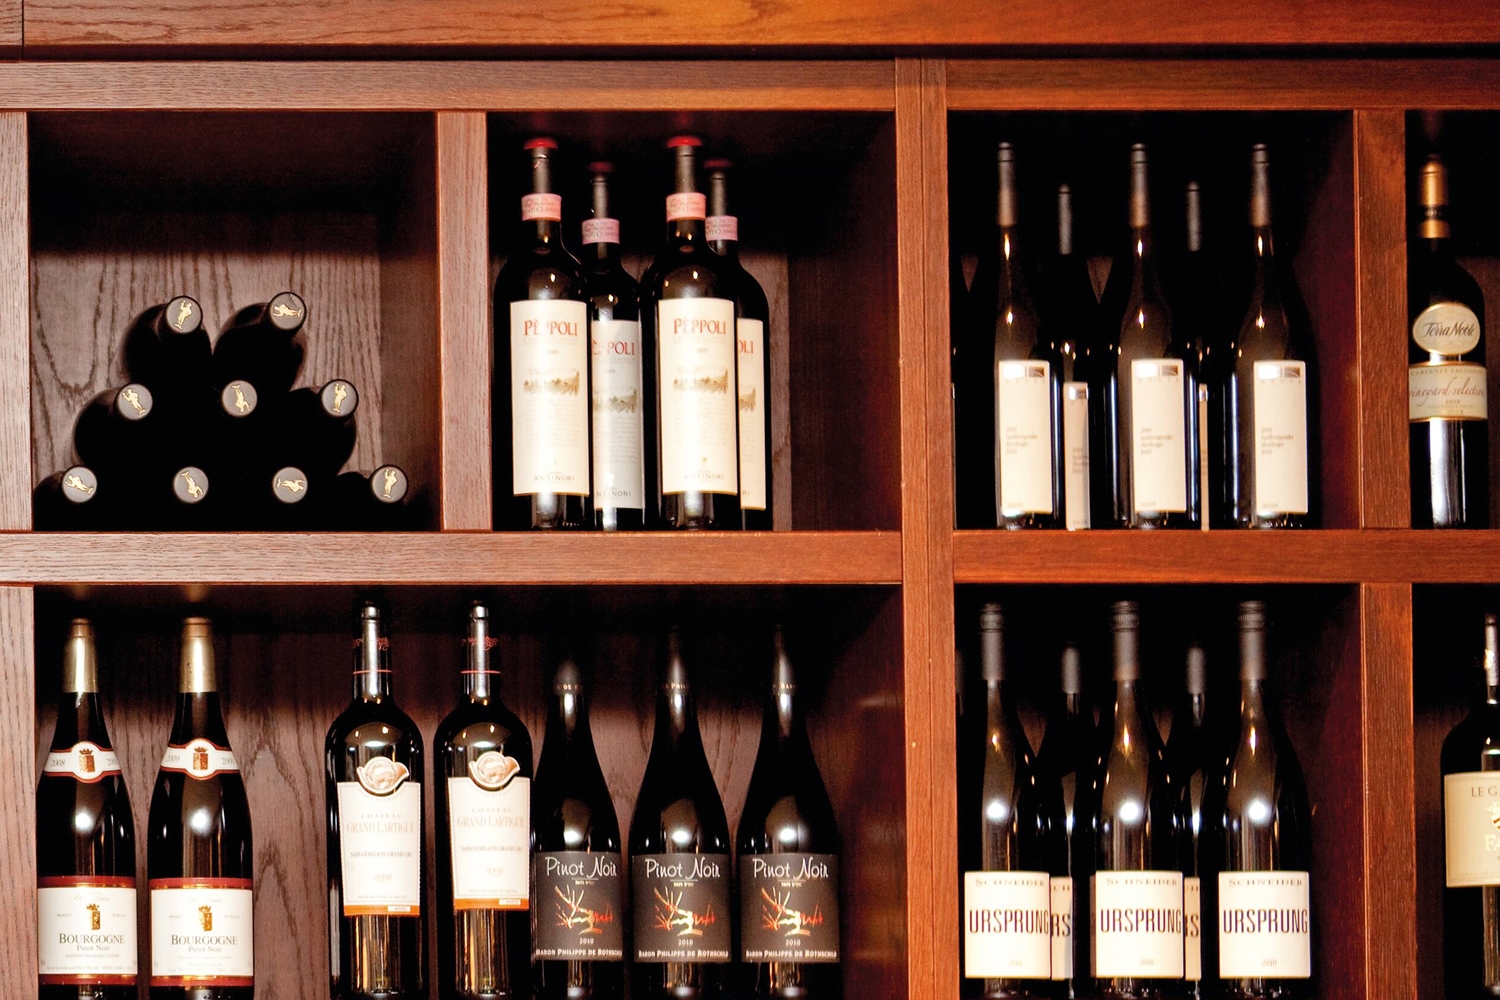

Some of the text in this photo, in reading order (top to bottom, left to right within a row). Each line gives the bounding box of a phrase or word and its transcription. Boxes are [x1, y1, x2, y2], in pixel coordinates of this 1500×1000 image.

[523, 319, 578, 337] PÈPOLI
[591, 338, 635, 356] ÈPOLI
[596, 490, 632, 498] NTINORI
[1471, 786, 1484, 797] LE
[545, 856, 584, 877] Pinot
[645, 858, 682, 879] Pinot
[752, 858, 790, 878] Pinot
[975, 878, 1045, 887] SCHNEIDER
[1106, 878, 1178, 887] SCHNEIDER
[1229, 878, 1303, 887] SCHNEIDER
[969, 909, 1049, 935] URSPRUNG
[1100, 908, 1182, 934] URSPRUNG
[1223, 908, 1308, 934] URSPRUNG
[59, 933, 126, 944] BOURGOGNE
[171, 934, 238, 945] BOURGOGNE
[76, 944, 111, 952] Pinot Noir
[557, 948, 587, 956] PHILIPPE
[656, 949, 686, 958] PHILIPPE
[764, 949, 793, 958] PHILIPPE
